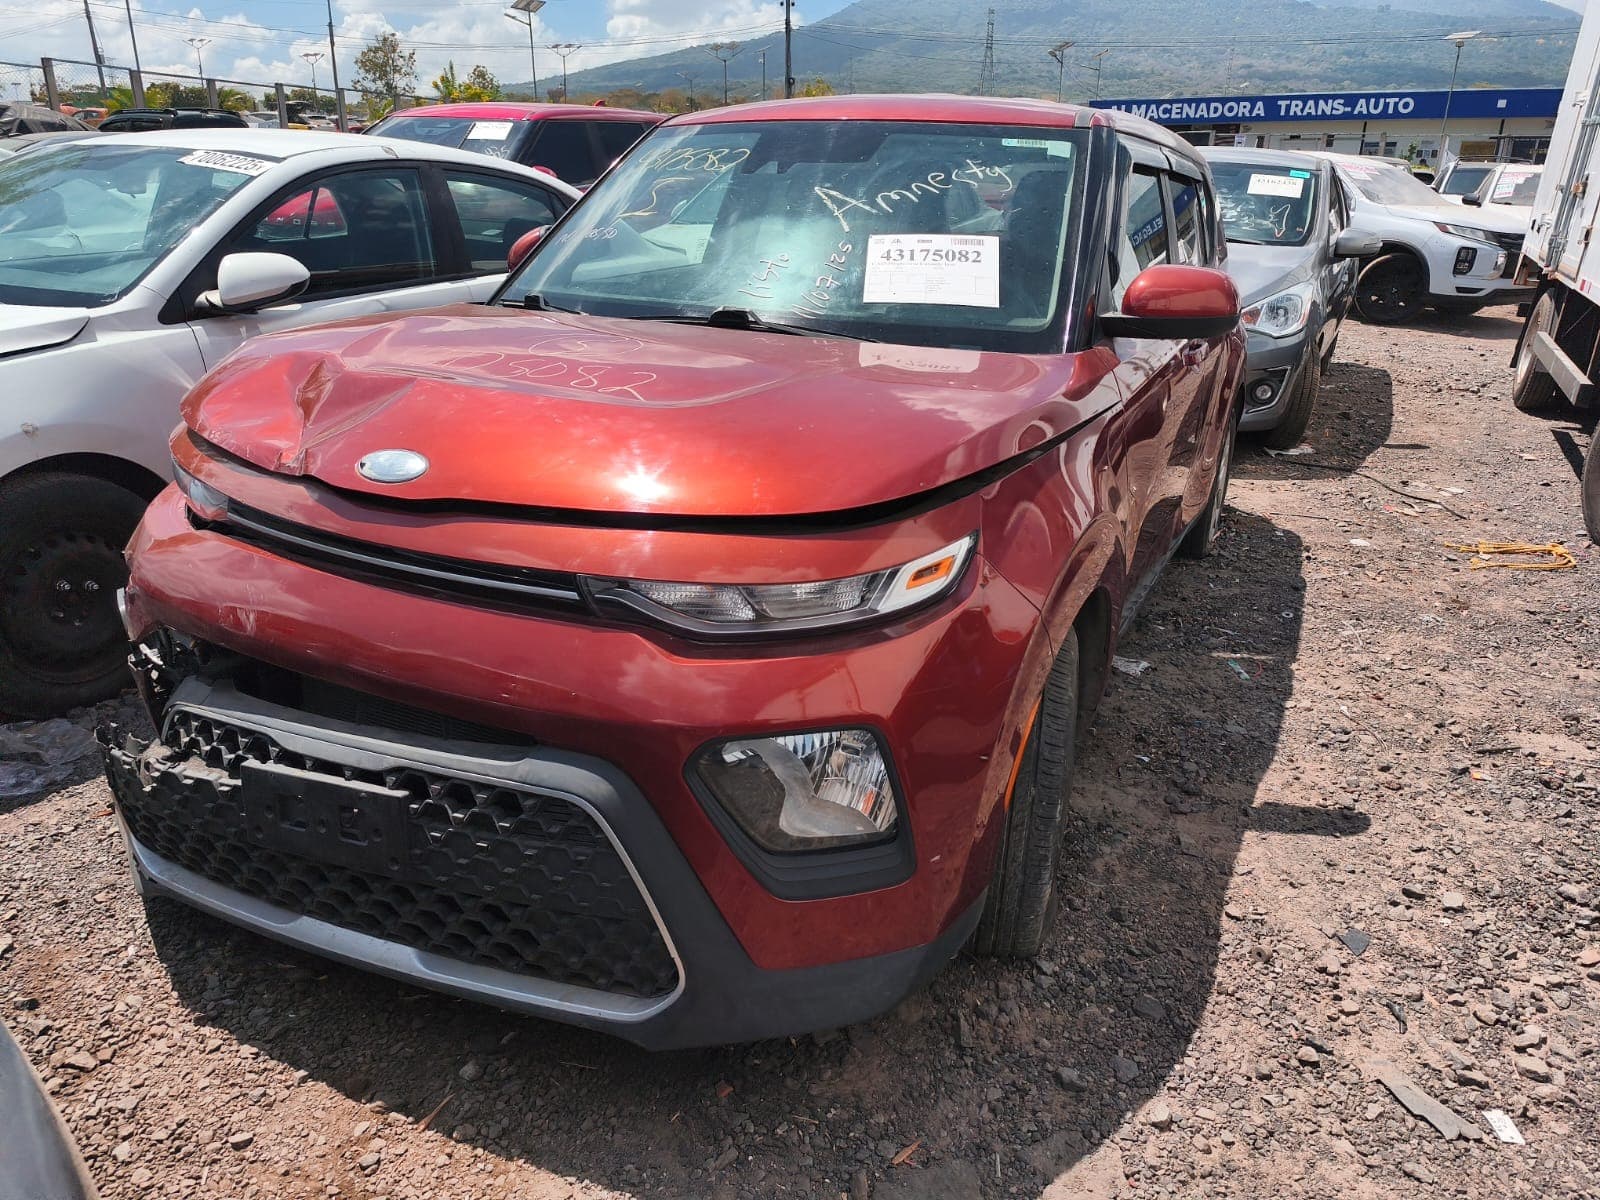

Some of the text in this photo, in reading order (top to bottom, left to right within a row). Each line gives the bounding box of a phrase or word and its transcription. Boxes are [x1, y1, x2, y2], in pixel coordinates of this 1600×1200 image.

[1278, 98, 1415, 116] TRANS-AUTO
[814, 159, 1013, 233] Amnesty
[880, 248, 983, 263] 43175082
